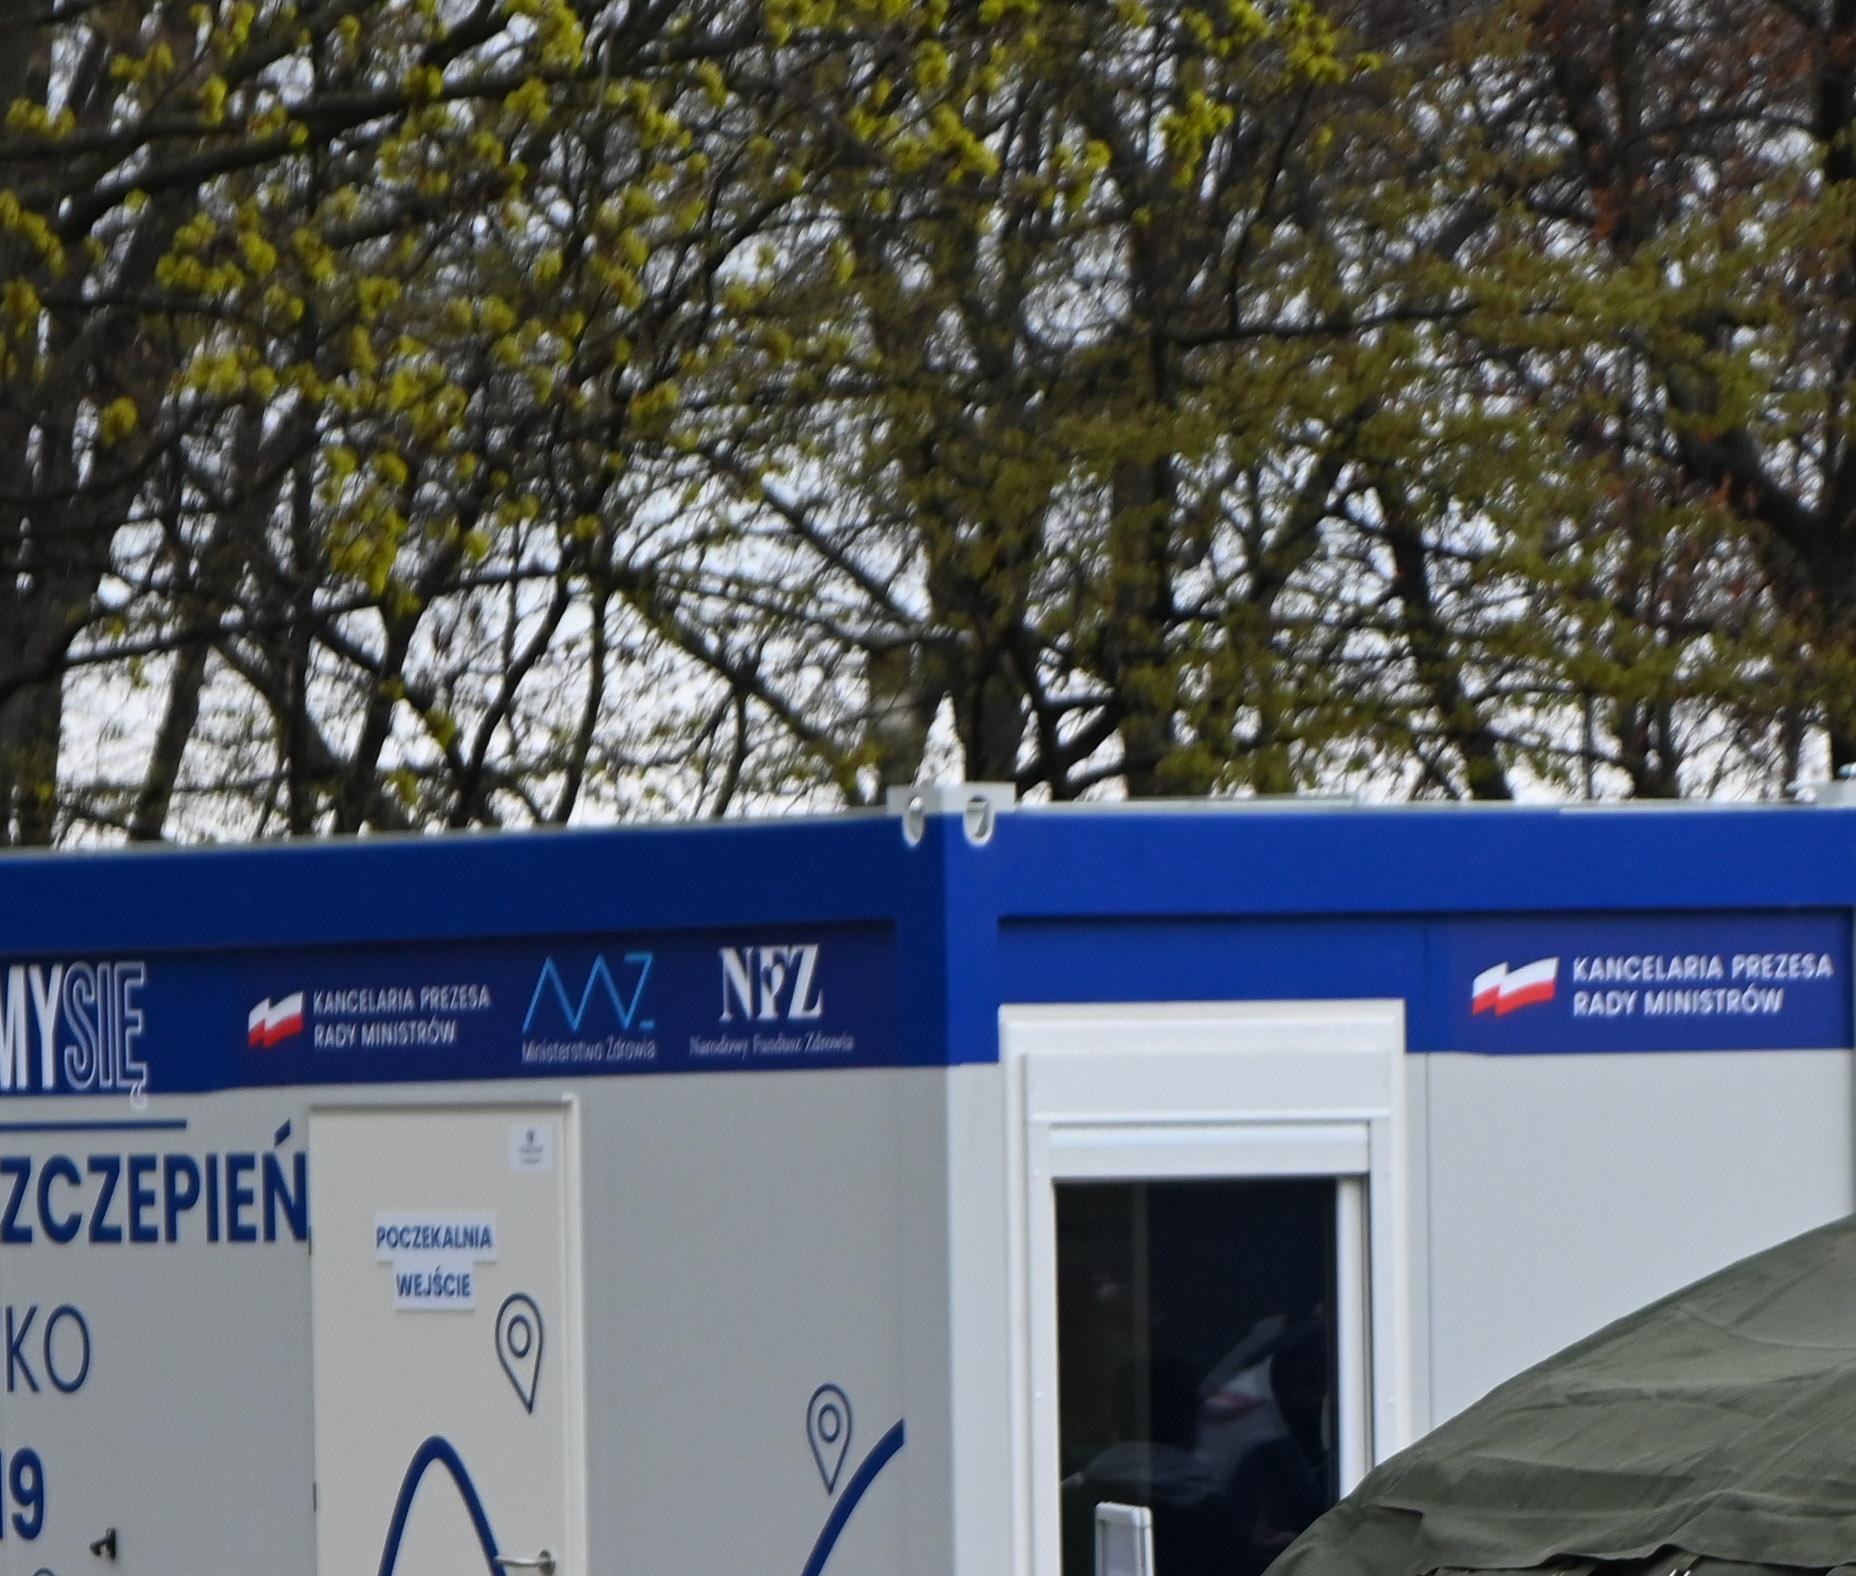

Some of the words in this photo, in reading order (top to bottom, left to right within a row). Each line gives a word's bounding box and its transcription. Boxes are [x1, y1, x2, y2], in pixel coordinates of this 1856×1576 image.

[718, 943, 824, 1023] NFZ
[1572, 955, 1724, 983] KANCELARIA
[1731, 953, 1835, 980] PREZESA
[312, 987, 416, 1016] KANCELARIA
[419, 983, 492, 1012] PREZESA
[1573, 989, 1639, 1017] RADY
[1643, 982, 1785, 1015] MINISTRÓW
[313, 1022, 358, 1049] RADY
[360, 1013, 459, 1047] MINISTRÓW
[521, 1038, 604, 1064] Ministerstwo
[605, 1036, 658, 1062] Zdrowia
[376, 1224, 493, 1249] POCZEKALNIA
[396, 1265, 472, 1298] WEJŚCIE
